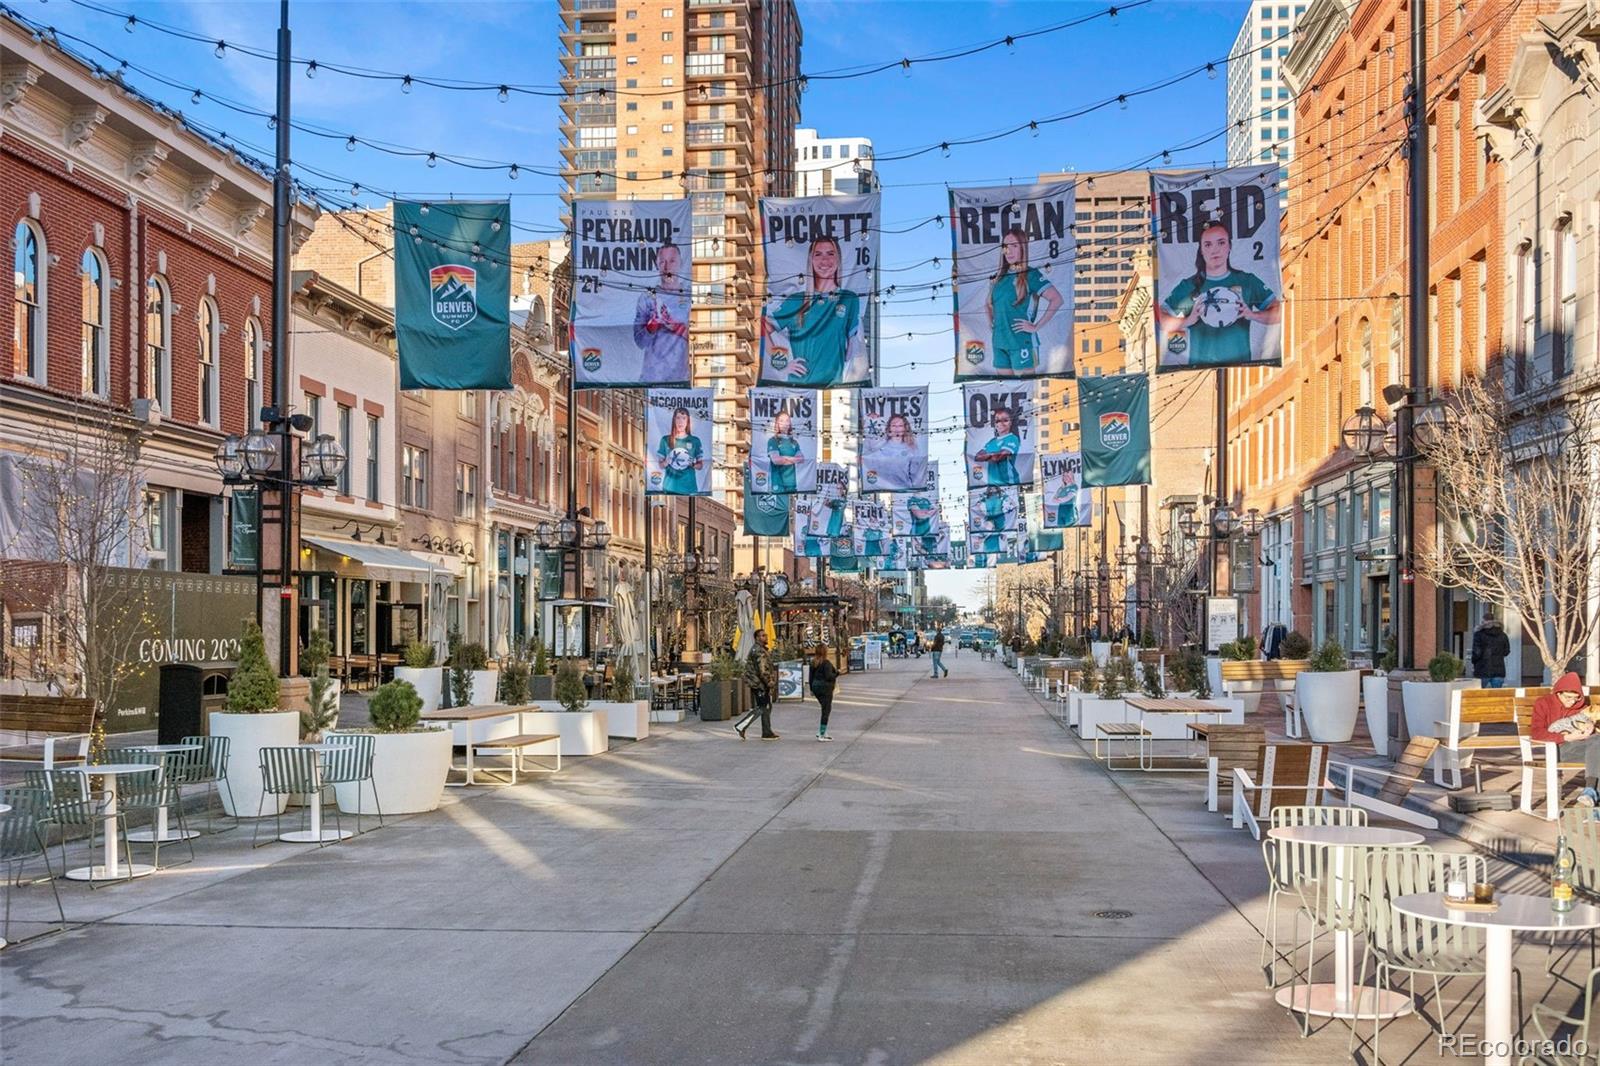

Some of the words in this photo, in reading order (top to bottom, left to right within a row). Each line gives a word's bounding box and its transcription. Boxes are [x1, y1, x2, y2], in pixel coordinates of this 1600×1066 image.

[582, 208, 634, 216] PAULINE
[1160, 185, 1266, 244] REID
[582, 218, 680, 243] PEYRAUD-
[769, 212, 872, 244] PICKETT
[960, 201, 1064, 244] REGAN
[582, 245, 660, 271] MAGNIN
[855, 246, 871, 266] 16
[1049, 240, 1059, 259] 8
[1253, 241, 1264, 260] 2
[437, 301, 474, 313] DENVER
[754, 398, 812, 418] MEANS
[864, 396, 921, 417] NYTES
[969, 391, 1027, 428] OKE
[1021, 429, 1028, 440] 7
[1103, 432, 1128, 441] DENVER
[140, 639, 206, 662] COMING
